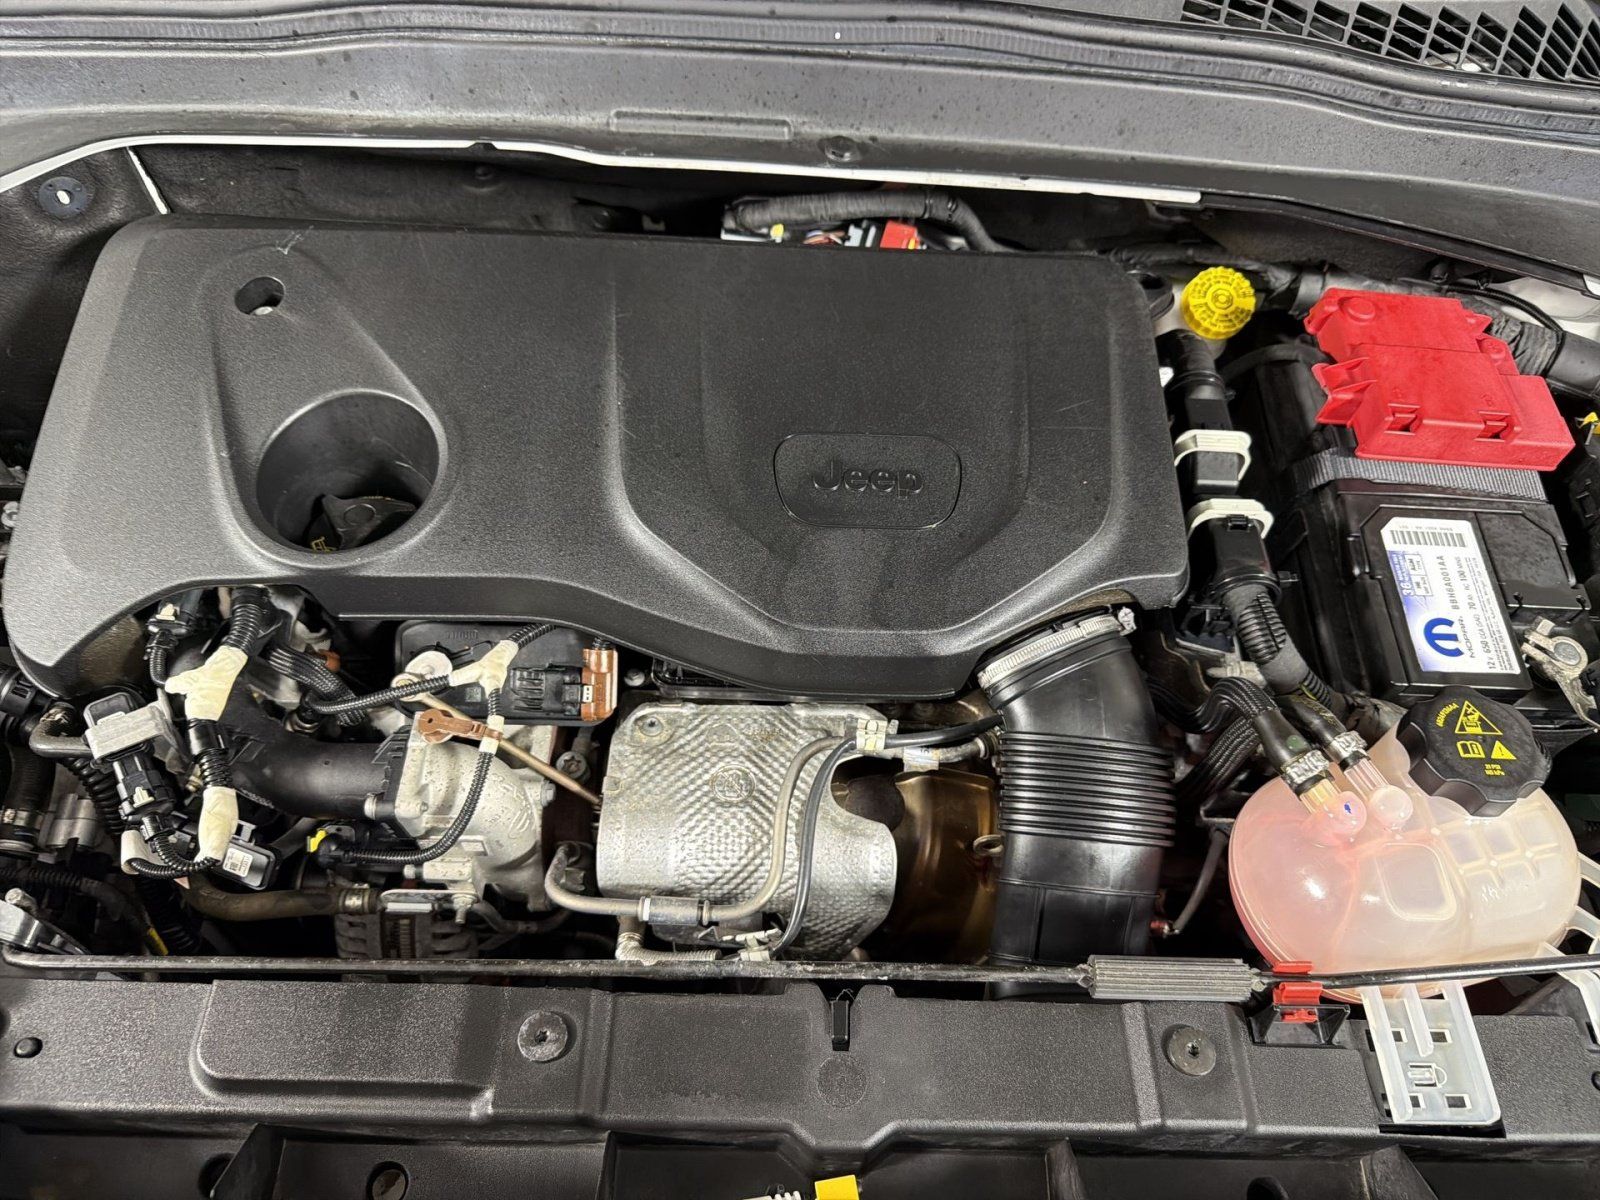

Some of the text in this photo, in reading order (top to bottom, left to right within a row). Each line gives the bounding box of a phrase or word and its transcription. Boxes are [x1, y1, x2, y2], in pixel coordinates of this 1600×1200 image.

[813, 459, 924, 499] Jeep
[1457, 571, 1468, 581] 100
[1401, 582, 1414, 595] 36
[1436, 556, 1460, 610] BBH6A001AA
[1467, 602, 1477, 610] 70
[1459, 618, 1476, 658] MOPAR
[1480, 641, 1492, 653] 650
